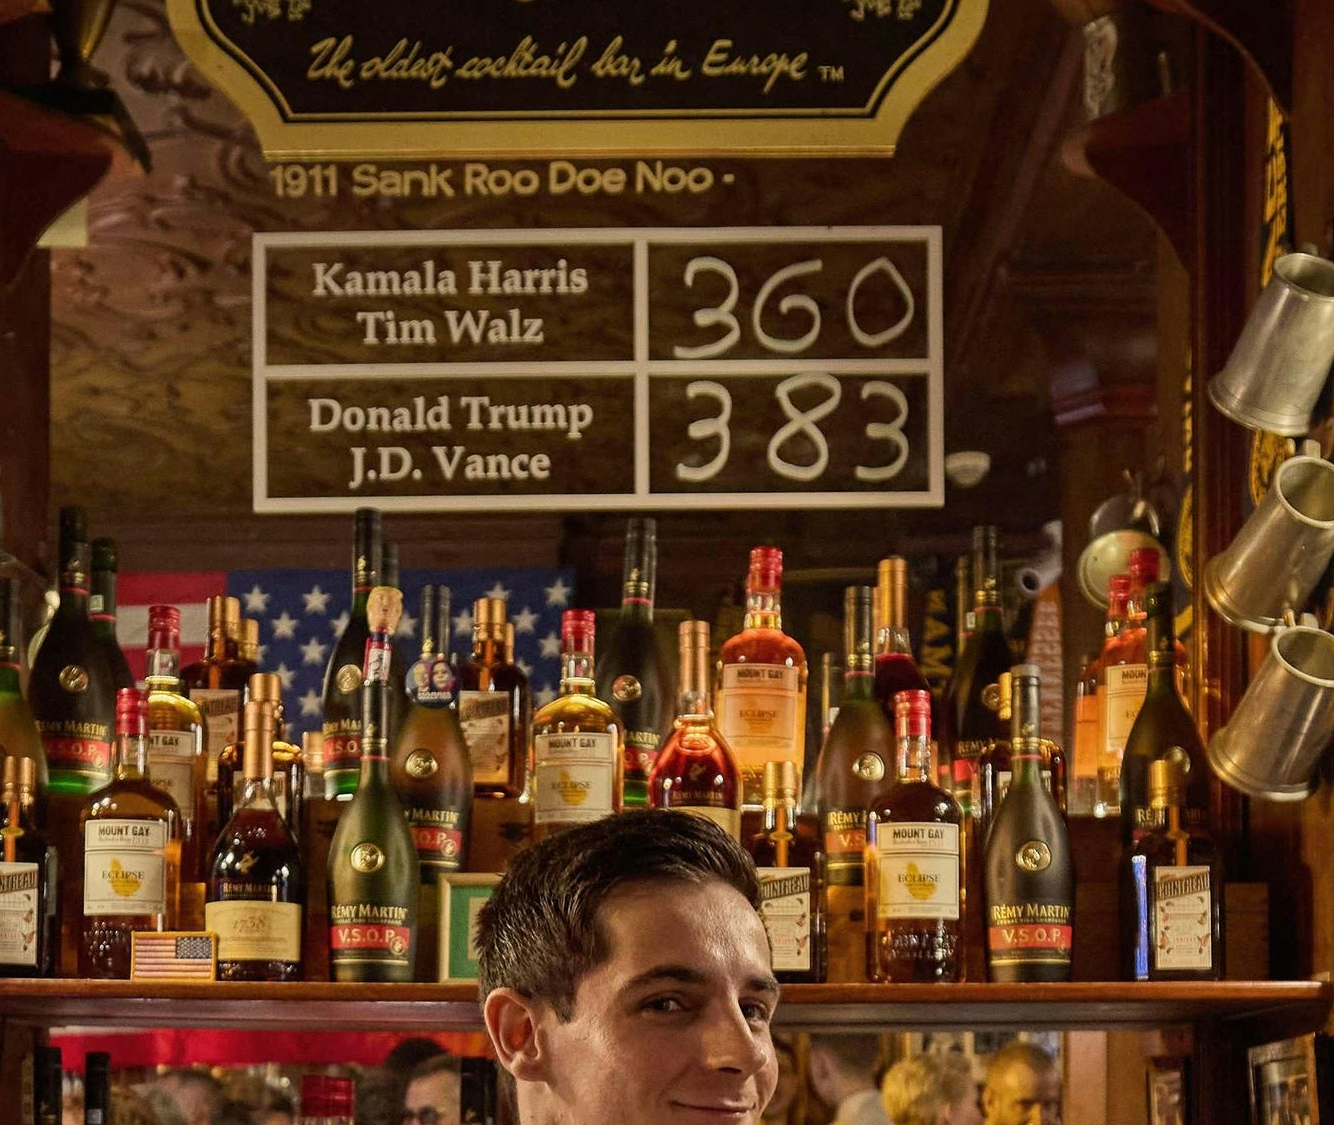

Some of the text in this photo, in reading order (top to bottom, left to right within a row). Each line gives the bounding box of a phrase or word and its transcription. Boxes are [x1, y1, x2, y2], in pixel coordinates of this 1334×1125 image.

[307, 34, 355, 89] The
[359, 37, 454, 89] oldest
[455, 34, 589, 88] cocktail
[590, 35, 646, 86] bar
[650, 38, 692, 80] in
[701, 38, 809, 94] Europe
[271, 160, 714, 198] 1911 Sank Roo Doe Noo
[312, 257, 589, 297] Kamala Harris
[671, 254, 917, 362] 360
[357, 307, 546, 346] Tim Walz
[308, 395, 595, 440] Donald Trump
[675, 371, 910, 485] 383
[348, 444, 552, 491] J.D. Vance
[736, 668, 783, 680] MOUNT GAY
[548, 737, 596, 750] MOUNT GAY
[412, 807, 459, 824] MARTIN
[830, 809, 859, 826] RÉMY
[98, 825, 151, 837] MOUNT GAY
[892, 827, 945, 840] MOUNT GAY
[101, 869, 145, 880] ECLIPSE
[898, 873, 941, 884] ECLIPSE
[331, 903, 409, 921] RÉMY MARTIN
[992, 902, 1025, 919] RÉMY
